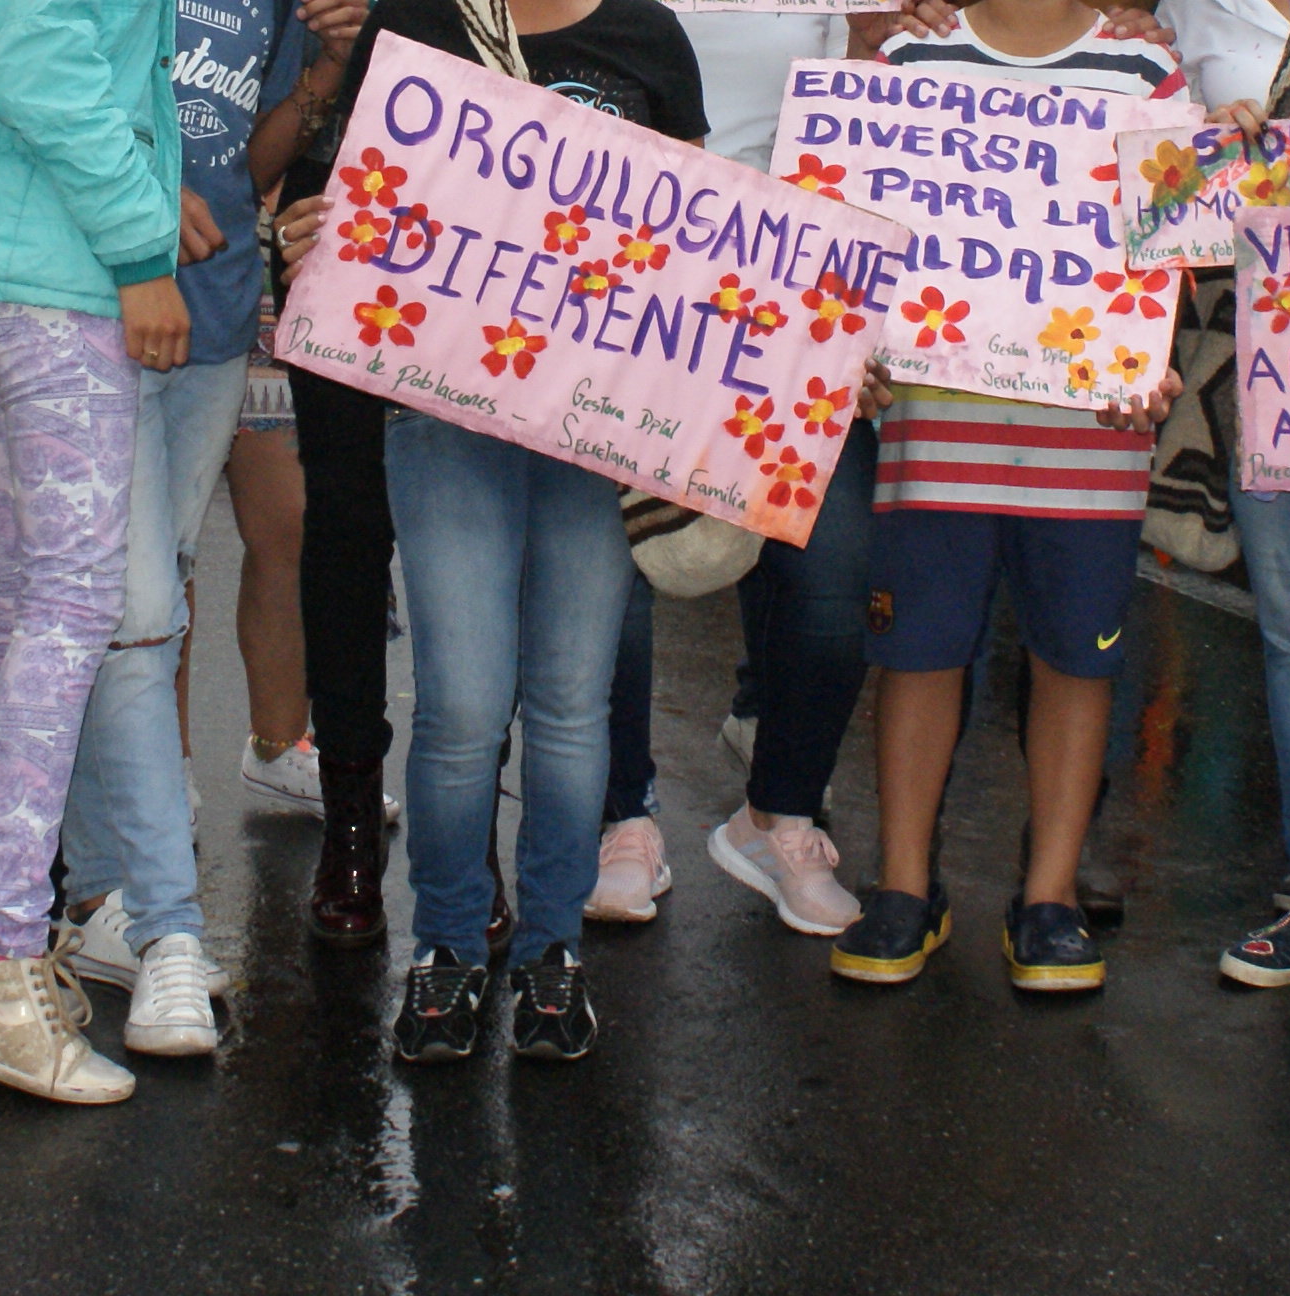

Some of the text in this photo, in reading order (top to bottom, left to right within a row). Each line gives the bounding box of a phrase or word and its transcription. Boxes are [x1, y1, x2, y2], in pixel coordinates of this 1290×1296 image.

[796, 112, 1061, 186] DIVERSA
[385, 74, 904, 313] ORGULLOSAMENTE
[862, 166, 1122, 249] PARA LA
[369, 204, 770, 396] DIFERENTE
[366, 349, 385, 375] de
[572, 377, 625, 422] Gestora
[557, 412, 748, 512] Secretaria de Familia
